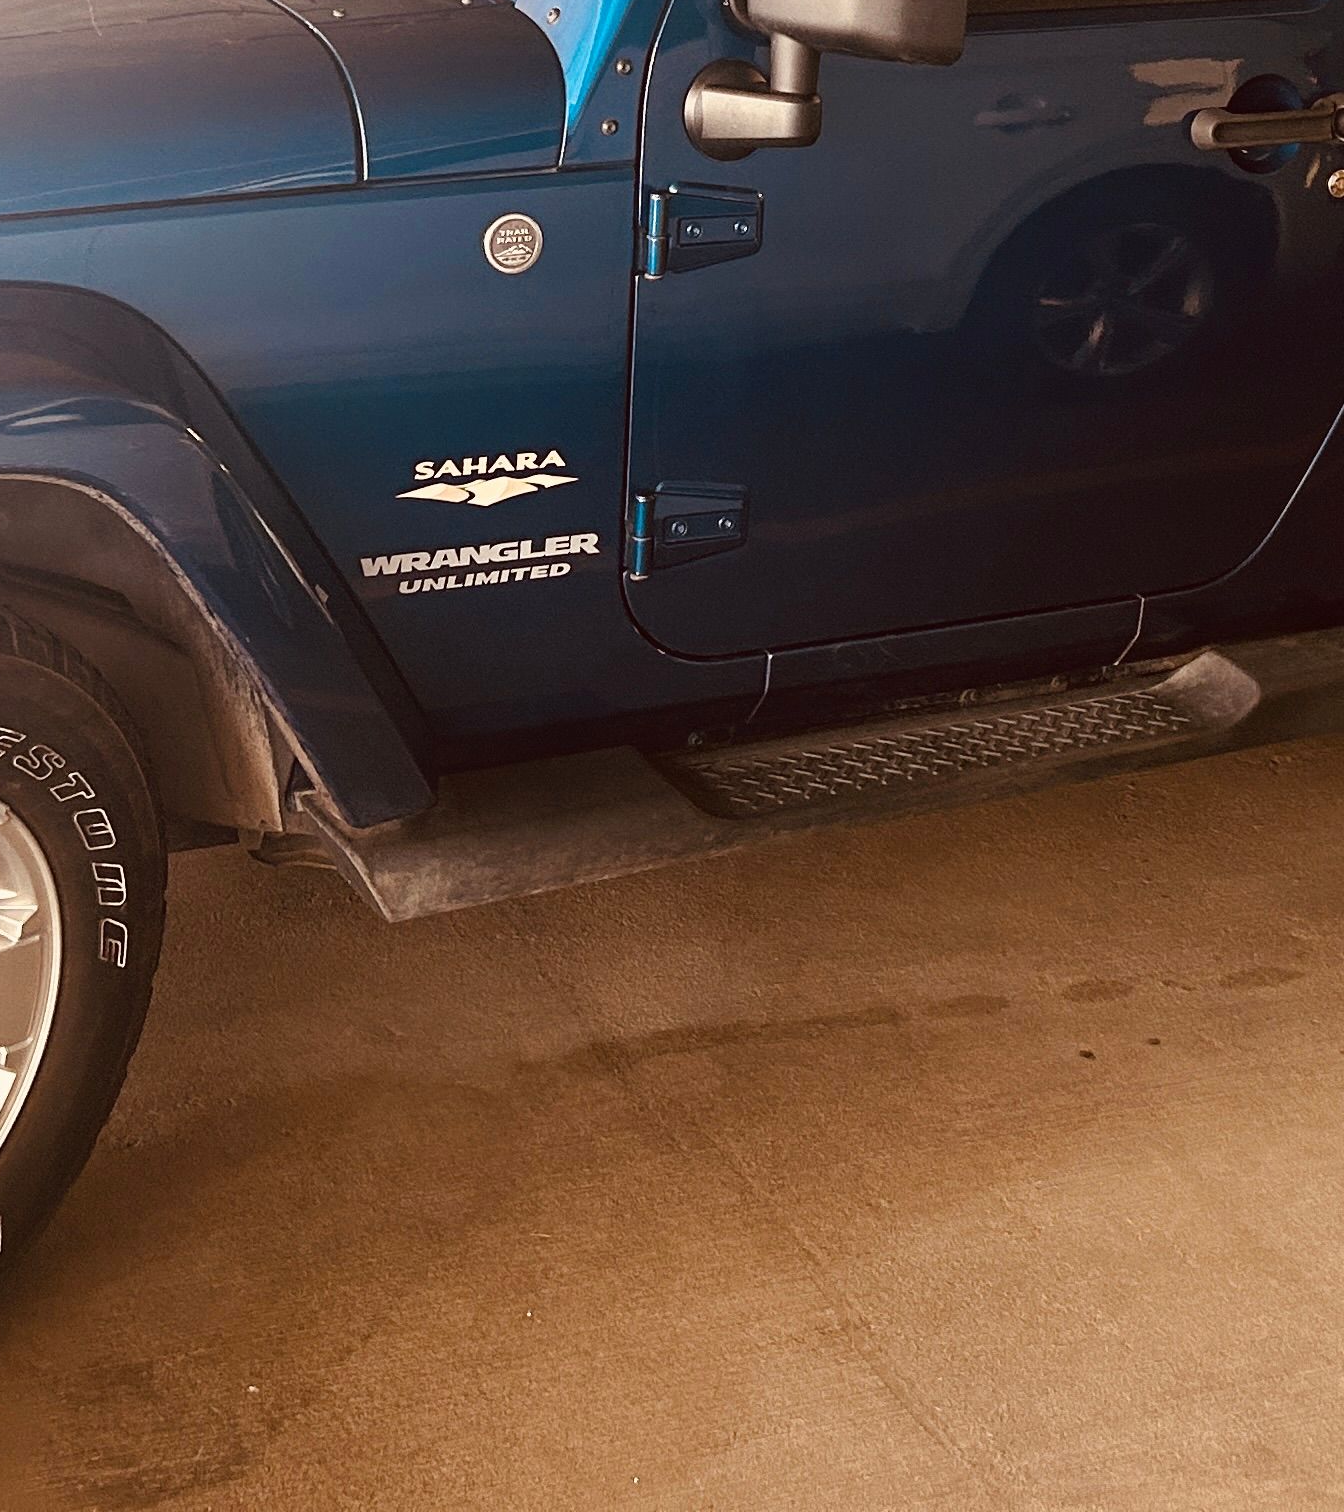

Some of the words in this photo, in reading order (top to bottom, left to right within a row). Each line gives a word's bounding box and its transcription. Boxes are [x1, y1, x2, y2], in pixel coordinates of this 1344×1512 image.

[496, 235, 532, 245] RATED
[499, 228, 529, 237] TRAIL
[414, 450, 566, 480] SAHARA
[360, 532, 600, 577] WRANGLER
[398, 562, 571, 594] UNLIMITED
